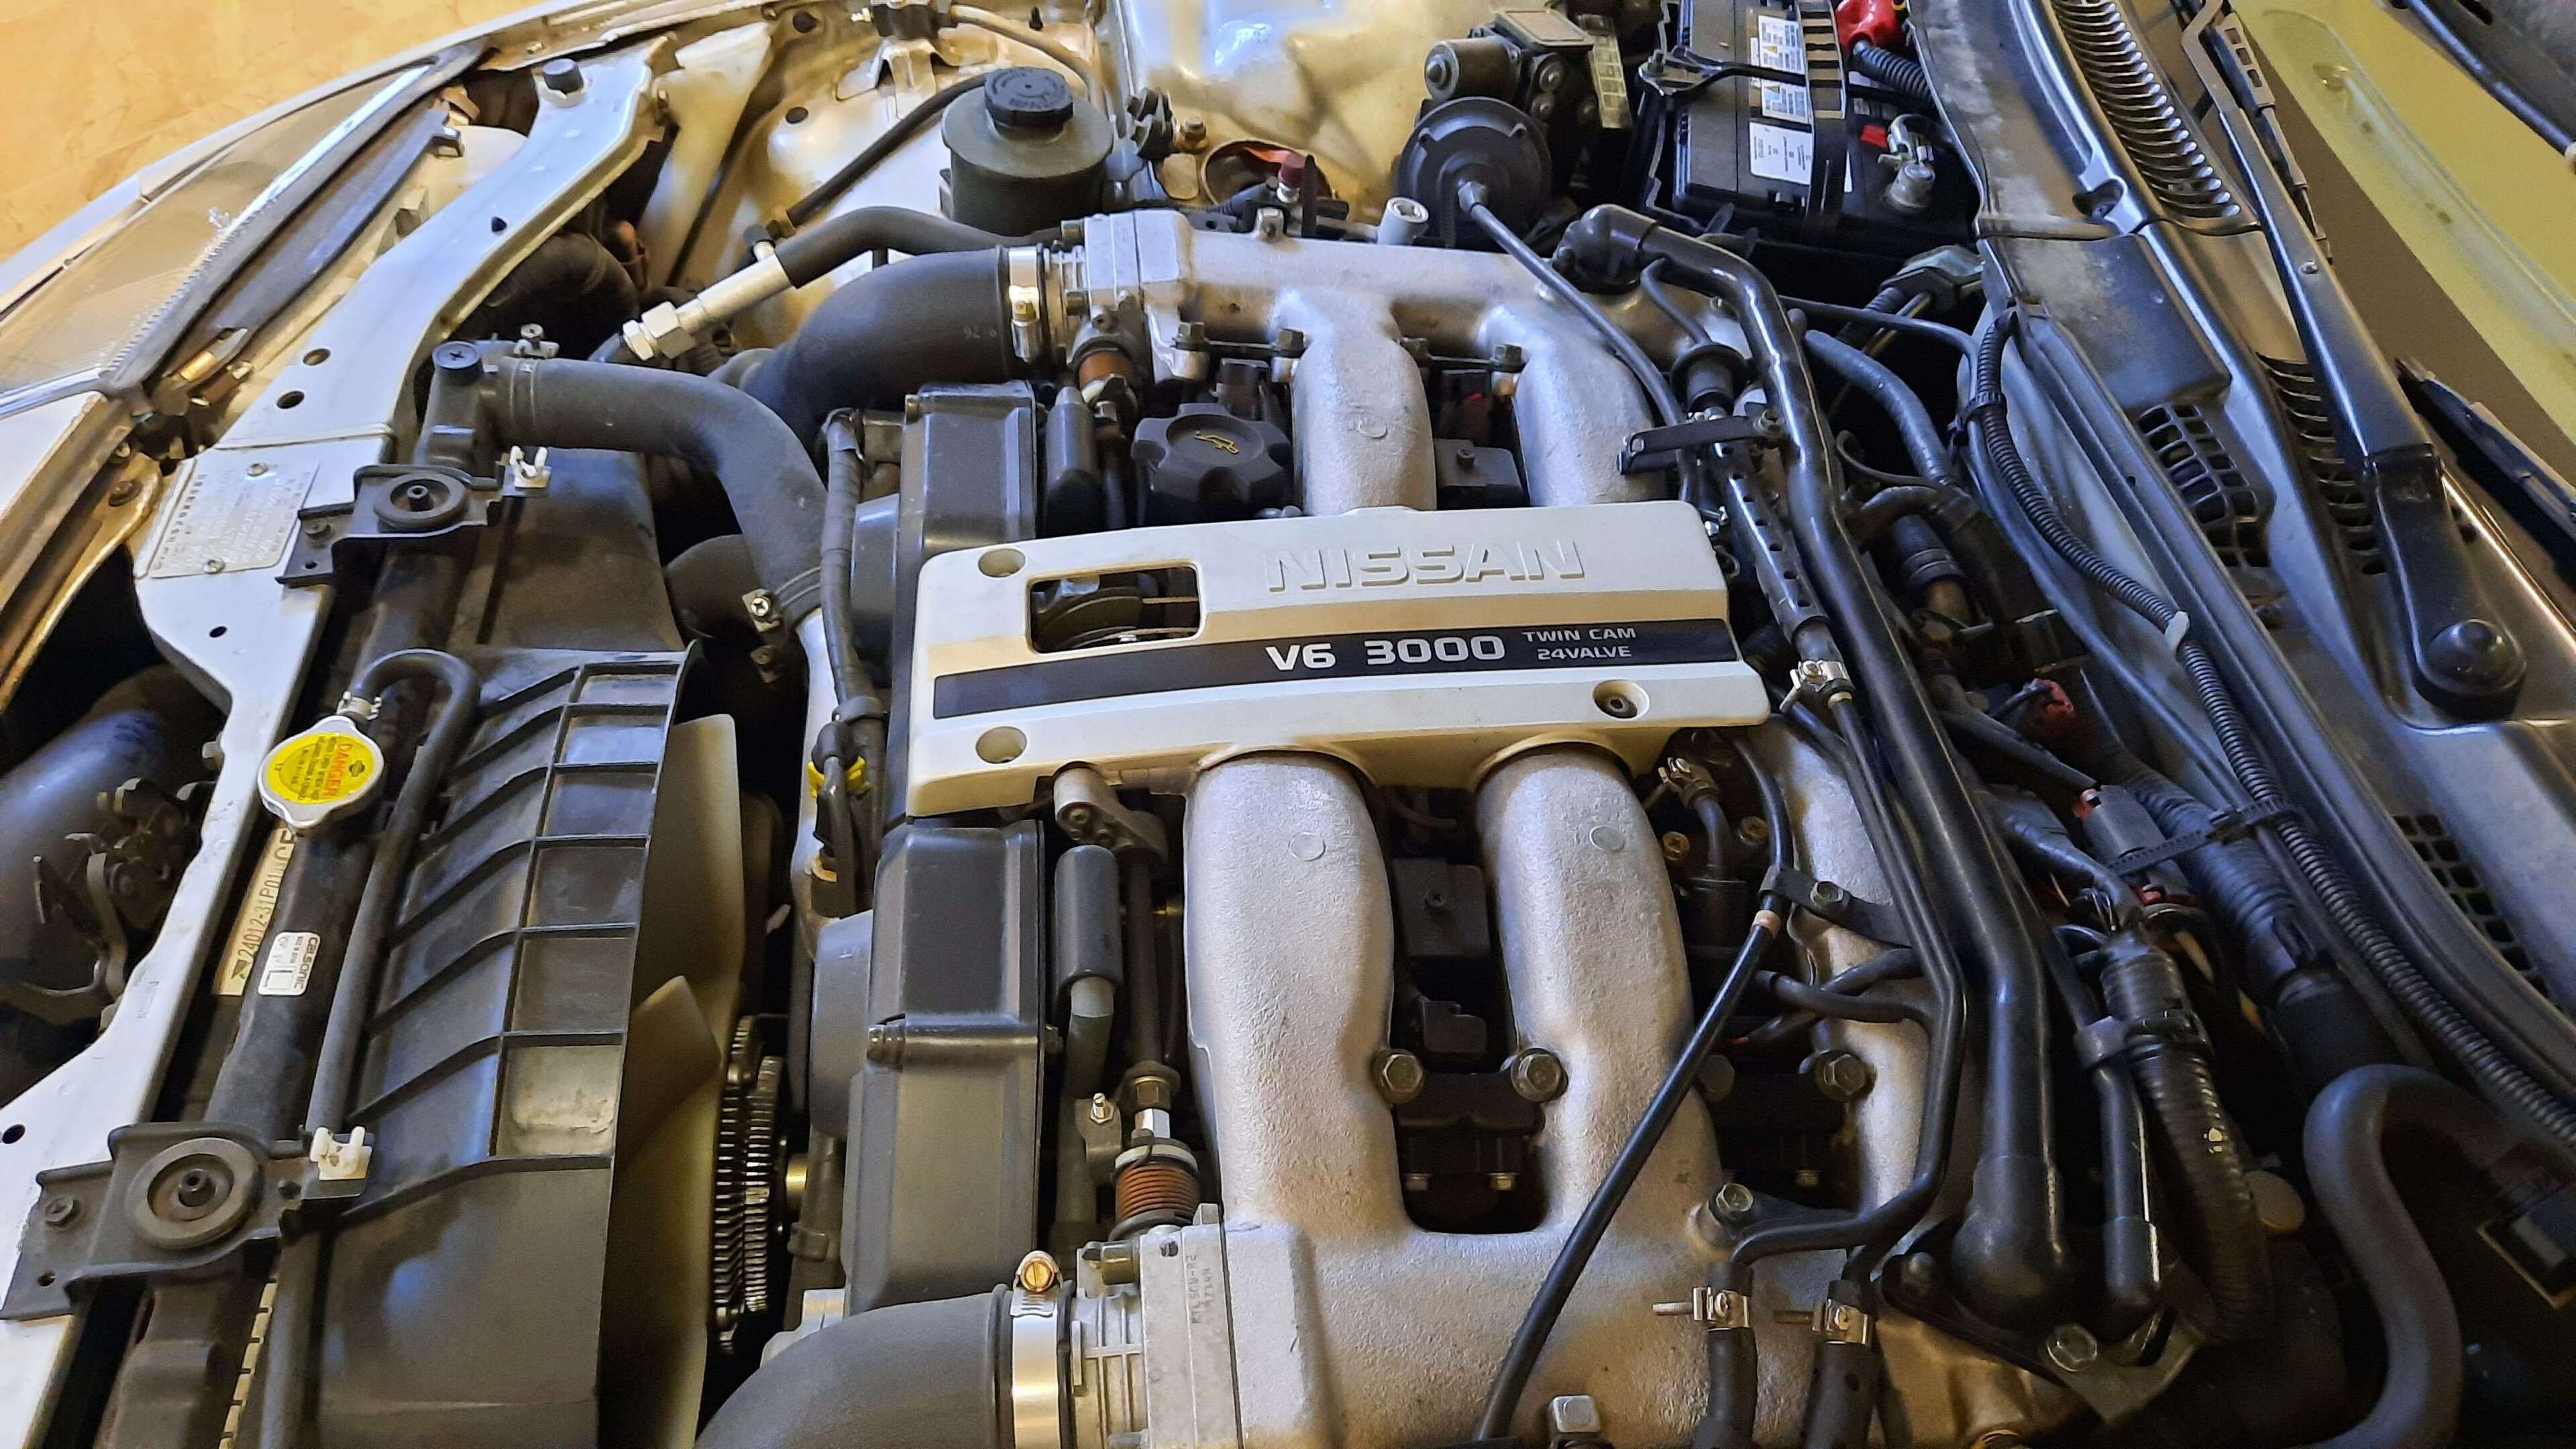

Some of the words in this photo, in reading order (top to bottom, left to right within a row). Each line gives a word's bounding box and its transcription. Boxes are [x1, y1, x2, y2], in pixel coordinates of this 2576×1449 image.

[1263, 540, 1585, 592] NISSAN
[1265, 643, 1337, 672] V6
[1363, 635, 1506, 665] 3000
[1522, 629, 1580, 643] TWIN
[1589, 627, 1637, 641] CAM
[1536, 645, 1633, 661] 24VALVE
[321, 743, 354, 796] DANGER
